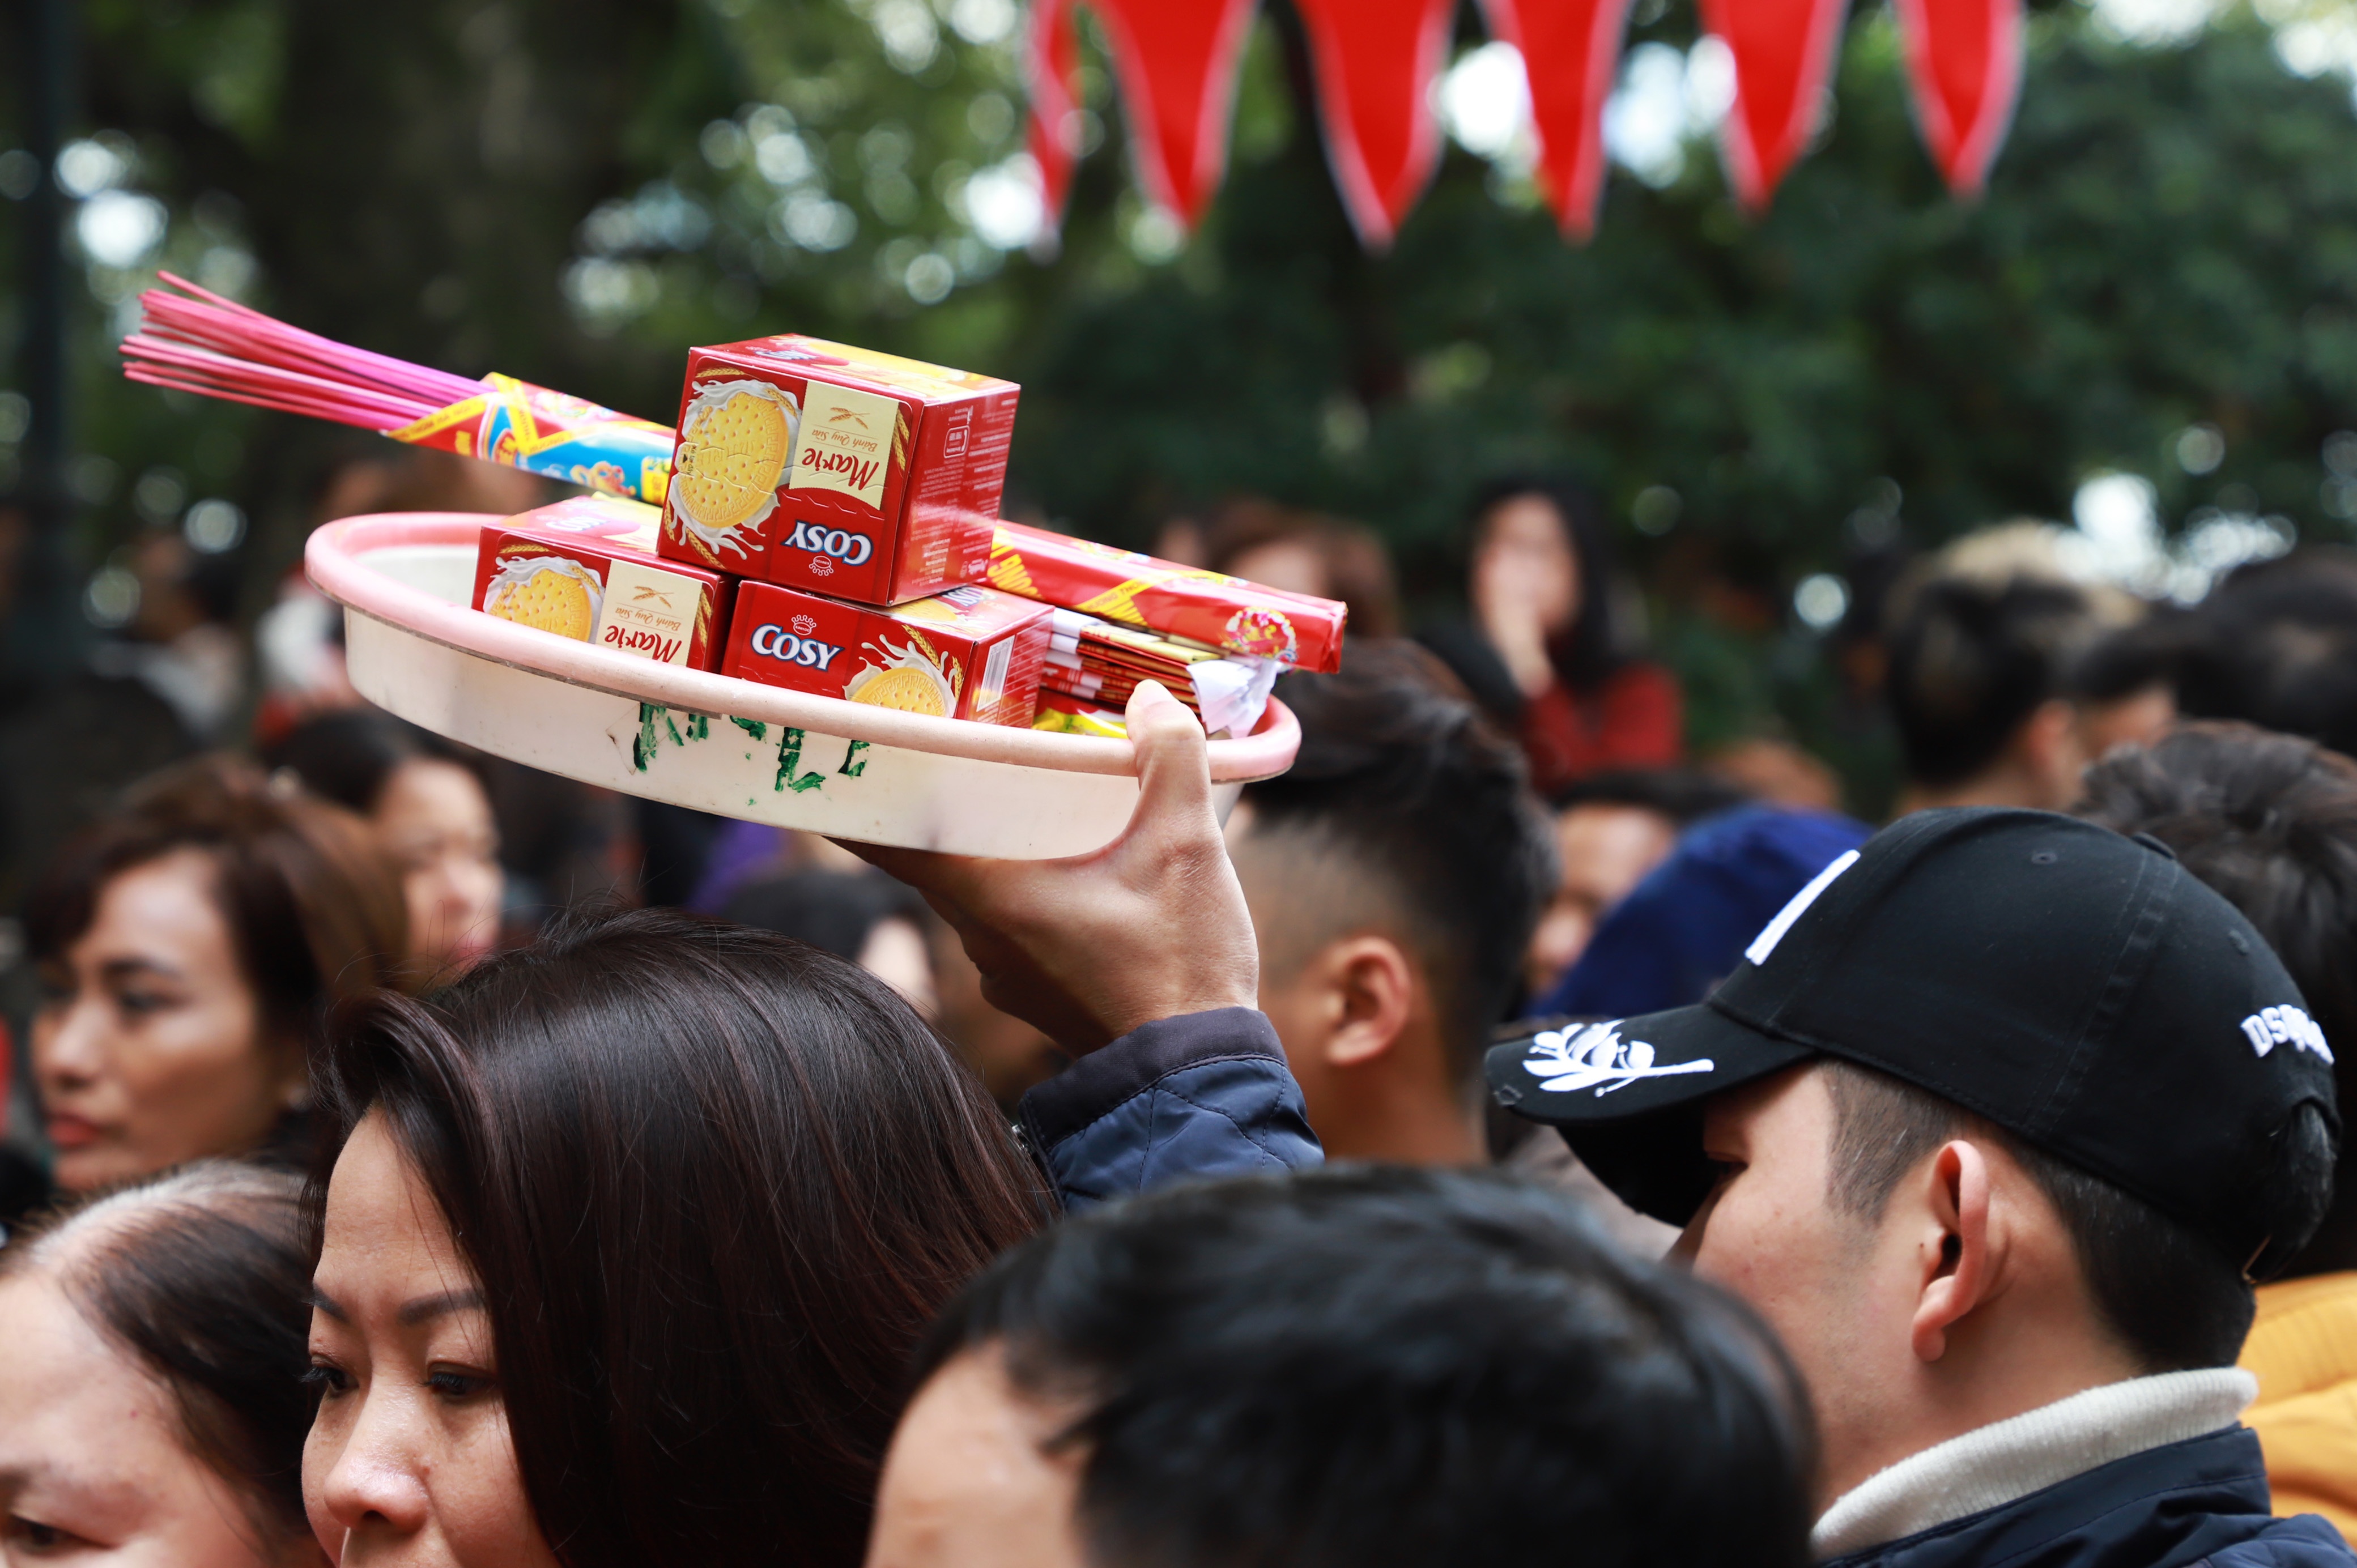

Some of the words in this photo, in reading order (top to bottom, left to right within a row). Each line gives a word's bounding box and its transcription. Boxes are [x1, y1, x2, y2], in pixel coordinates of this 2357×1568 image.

[831, 431, 850, 446] Quy
[853, 438, 878, 452] Bánh
[802, 448, 879, 491] Marie
[781, 520, 874, 565] COSY
[635, 610, 654, 624] Quy
[656, 617, 681, 631] Bánh
[605, 625, 682, 663] Marie
[751, 623, 845, 671] COSY
